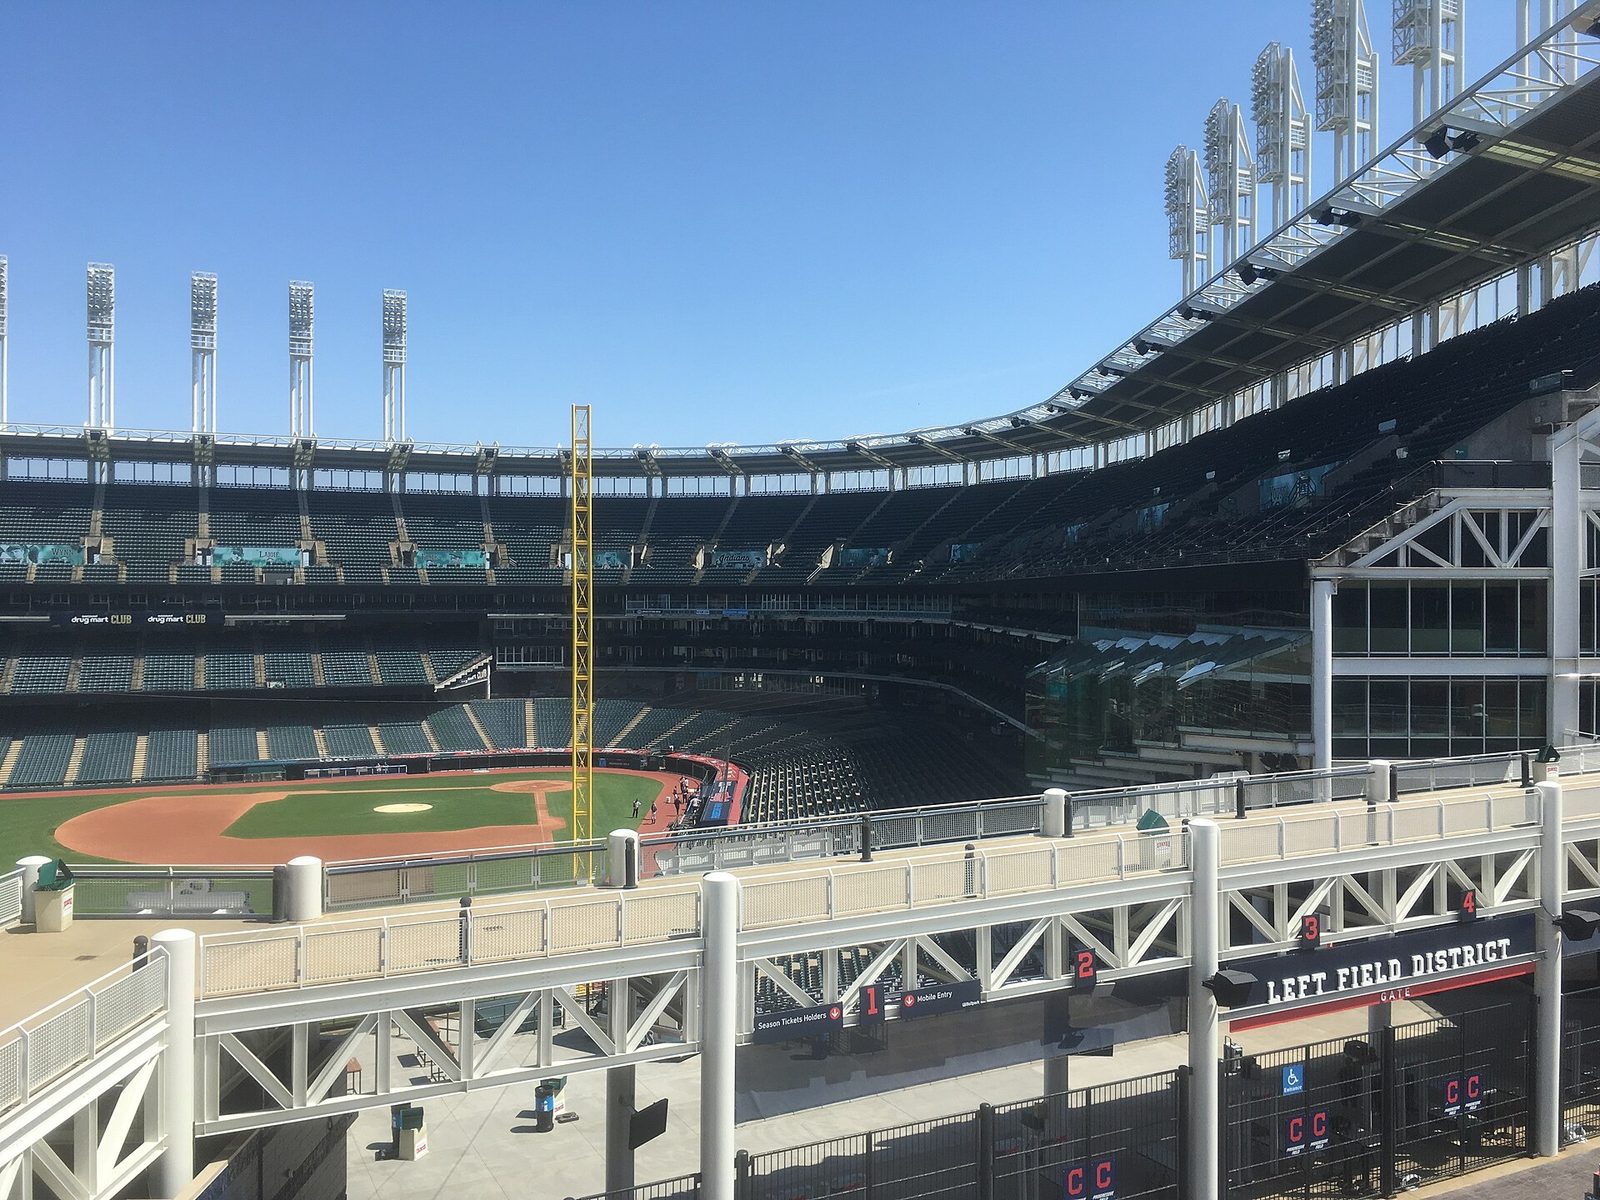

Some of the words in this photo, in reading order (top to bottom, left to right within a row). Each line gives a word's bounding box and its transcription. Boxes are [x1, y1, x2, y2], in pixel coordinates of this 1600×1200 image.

[71, 616, 90, 624] drug
[110, 614, 132, 624] CLUB
[147, 616, 166, 624] drug
[185, 614, 207, 624] CLUB
[1463, 891, 1475, 913] 4
[1304, 917, 1318, 941] 3
[1077, 951, 1094, 979] 2
[1267, 971, 1327, 1004] LEFT
[1336, 958, 1401, 991] FIELD
[1411, 938, 1511, 976] DISTRICT
[866, 987, 878, 1015] 1
[917, 993, 937, 1003] Mobile
[936, 991, 953, 999] Entry
[1380, 987, 1411, 1002] GATE
[758, 1021, 781, 1030] Season
[781, 1016, 803, 1026] Tickets
[803, 1012, 827, 1022] Holders
[1447, 1080, 1458, 1103] C
[1468, 1075, 1479, 1098] C
[1290, 1117, 1303, 1142] C
[1313, 1112, 1326, 1137] C
[1068, 1167, 1083, 1195] C
[1097, 1161, 1111, 1189] C
